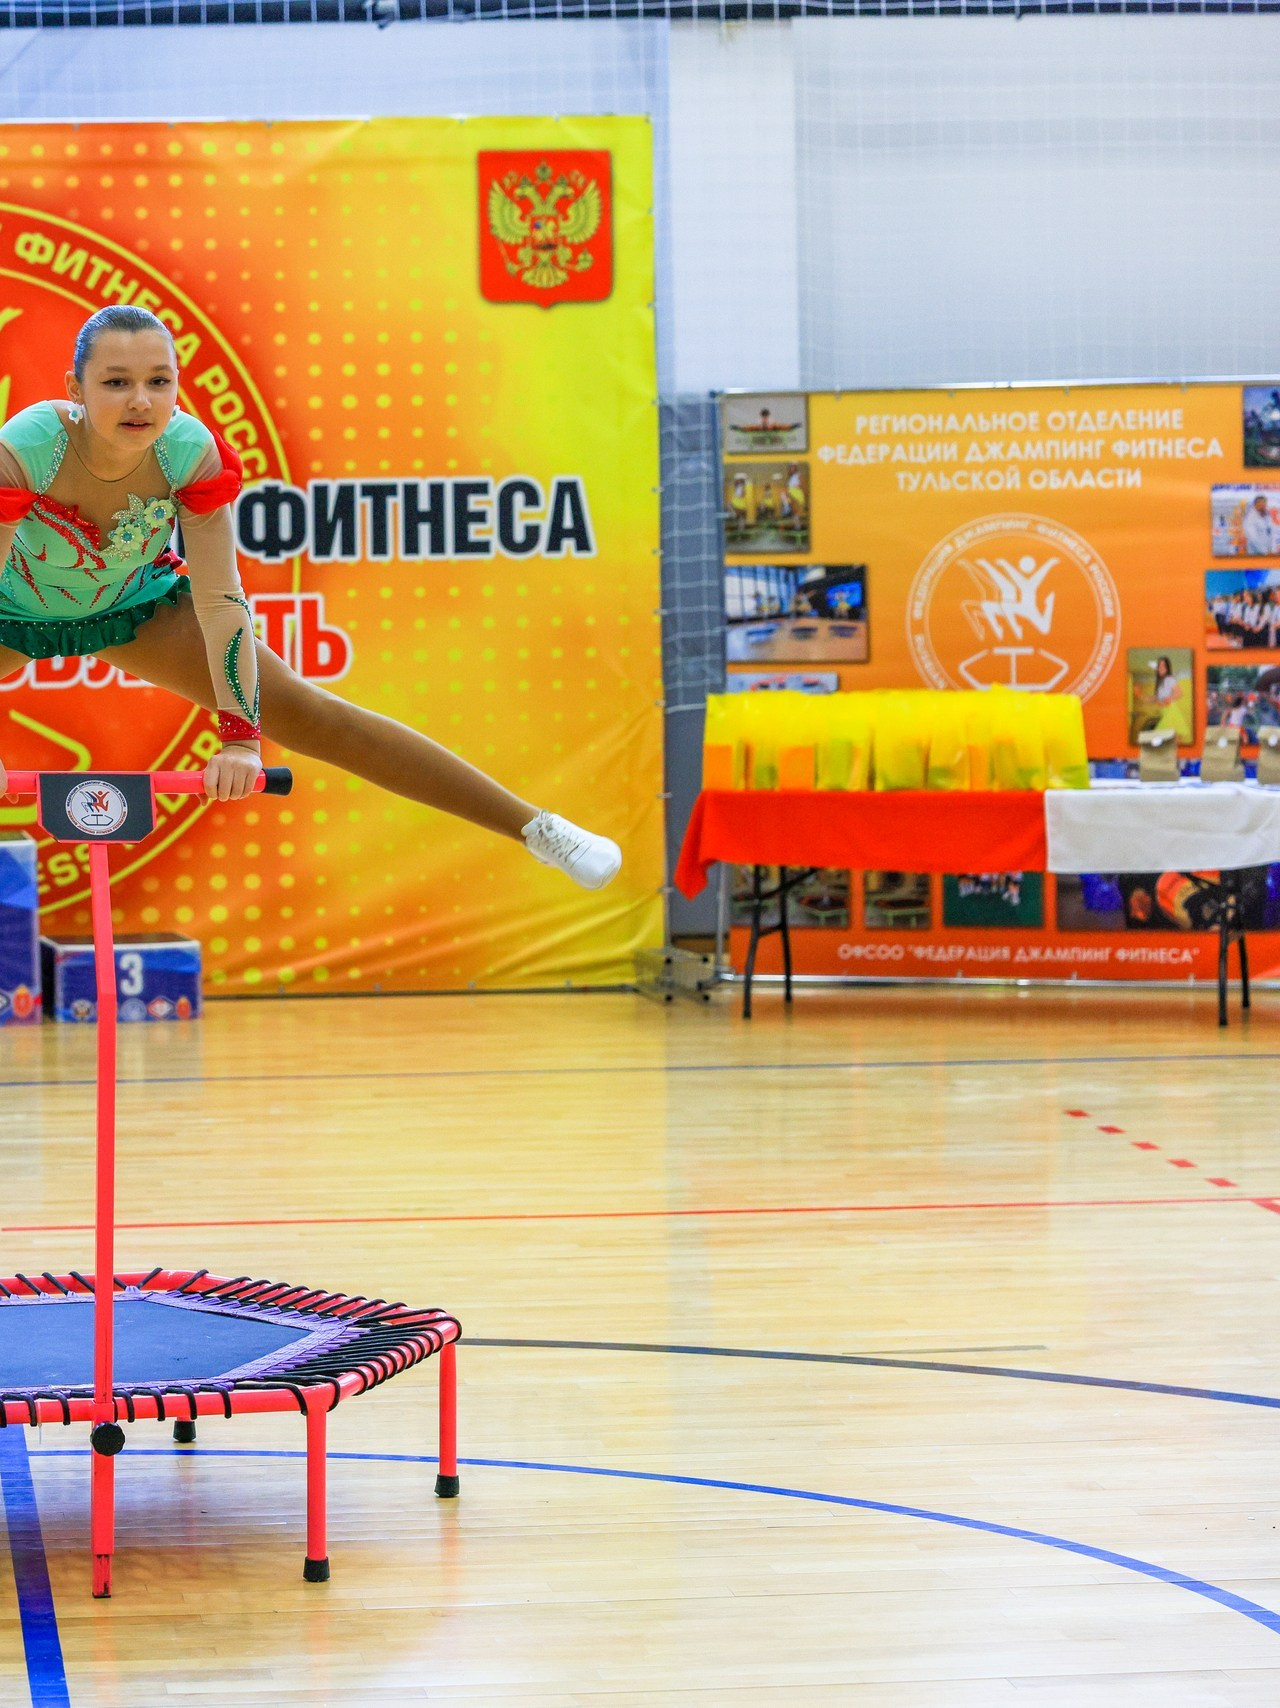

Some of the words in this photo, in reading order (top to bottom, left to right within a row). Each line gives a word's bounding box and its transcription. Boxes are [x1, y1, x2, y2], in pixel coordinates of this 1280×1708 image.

[856, 410, 1041, 436] РЕГИОНАЛЬНОЕ
[1046, 408, 1184, 434] ОТДЕЛЕНИЕ
[816, 440, 959, 466] ФЕДЕРАЦИИ
[964, 438, 1106, 465] ДЖАМПИНГ
[1111, 436, 1224, 460] ФИТНЕСА
[895, 466, 1021, 492] ТУЛЬСКОЙ
[1027, 467, 1142, 490] ОБЛАСТИ
[237, 478, 596, 560] ФИТНЕСА
[120, 953, 144, 997] 3
